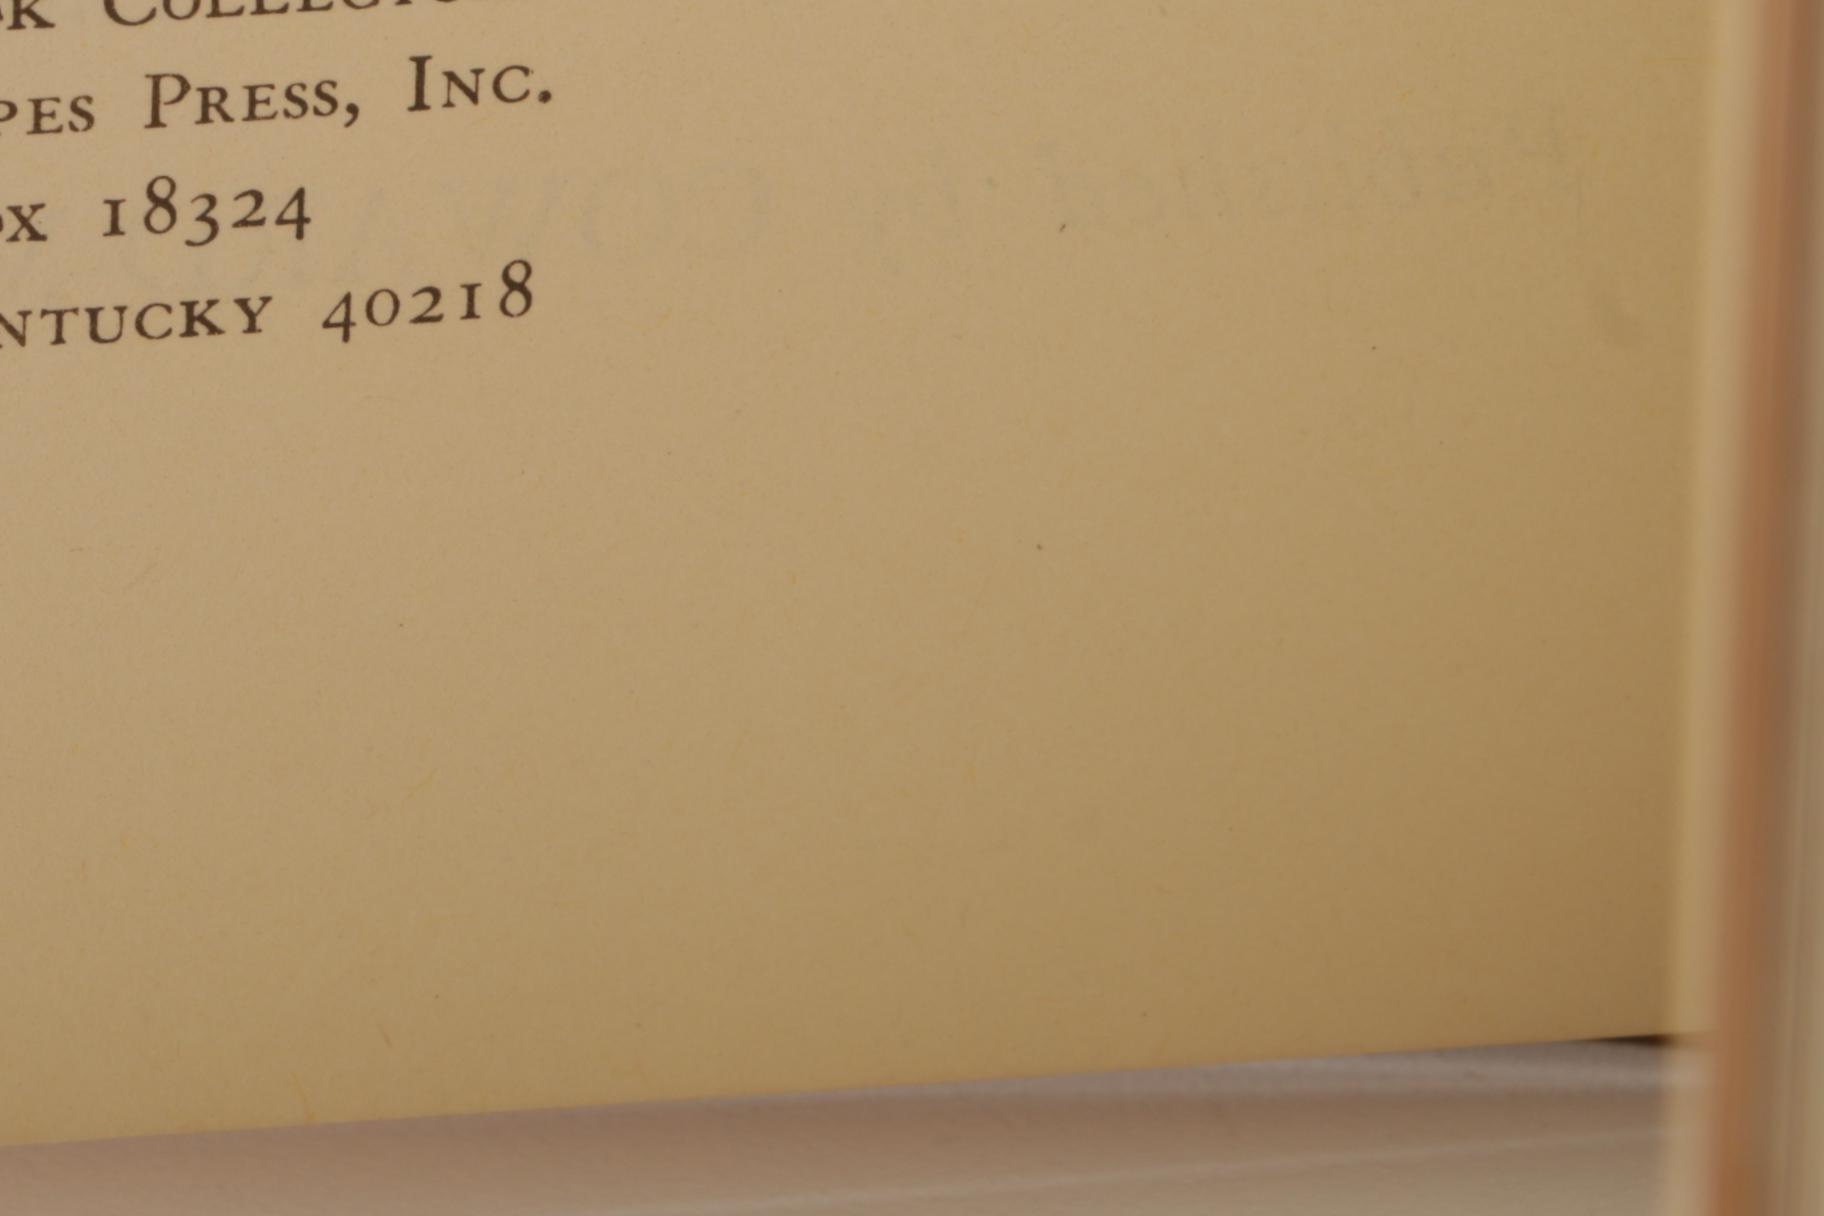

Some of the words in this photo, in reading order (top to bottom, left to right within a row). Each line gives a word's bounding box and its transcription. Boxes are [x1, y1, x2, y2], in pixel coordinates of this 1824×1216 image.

[143, 72, 361, 130] PRESS,
[406, 54, 553, 113] INC.
[102, 174, 312, 248] 18324
[321, 258, 534, 345] 40218
